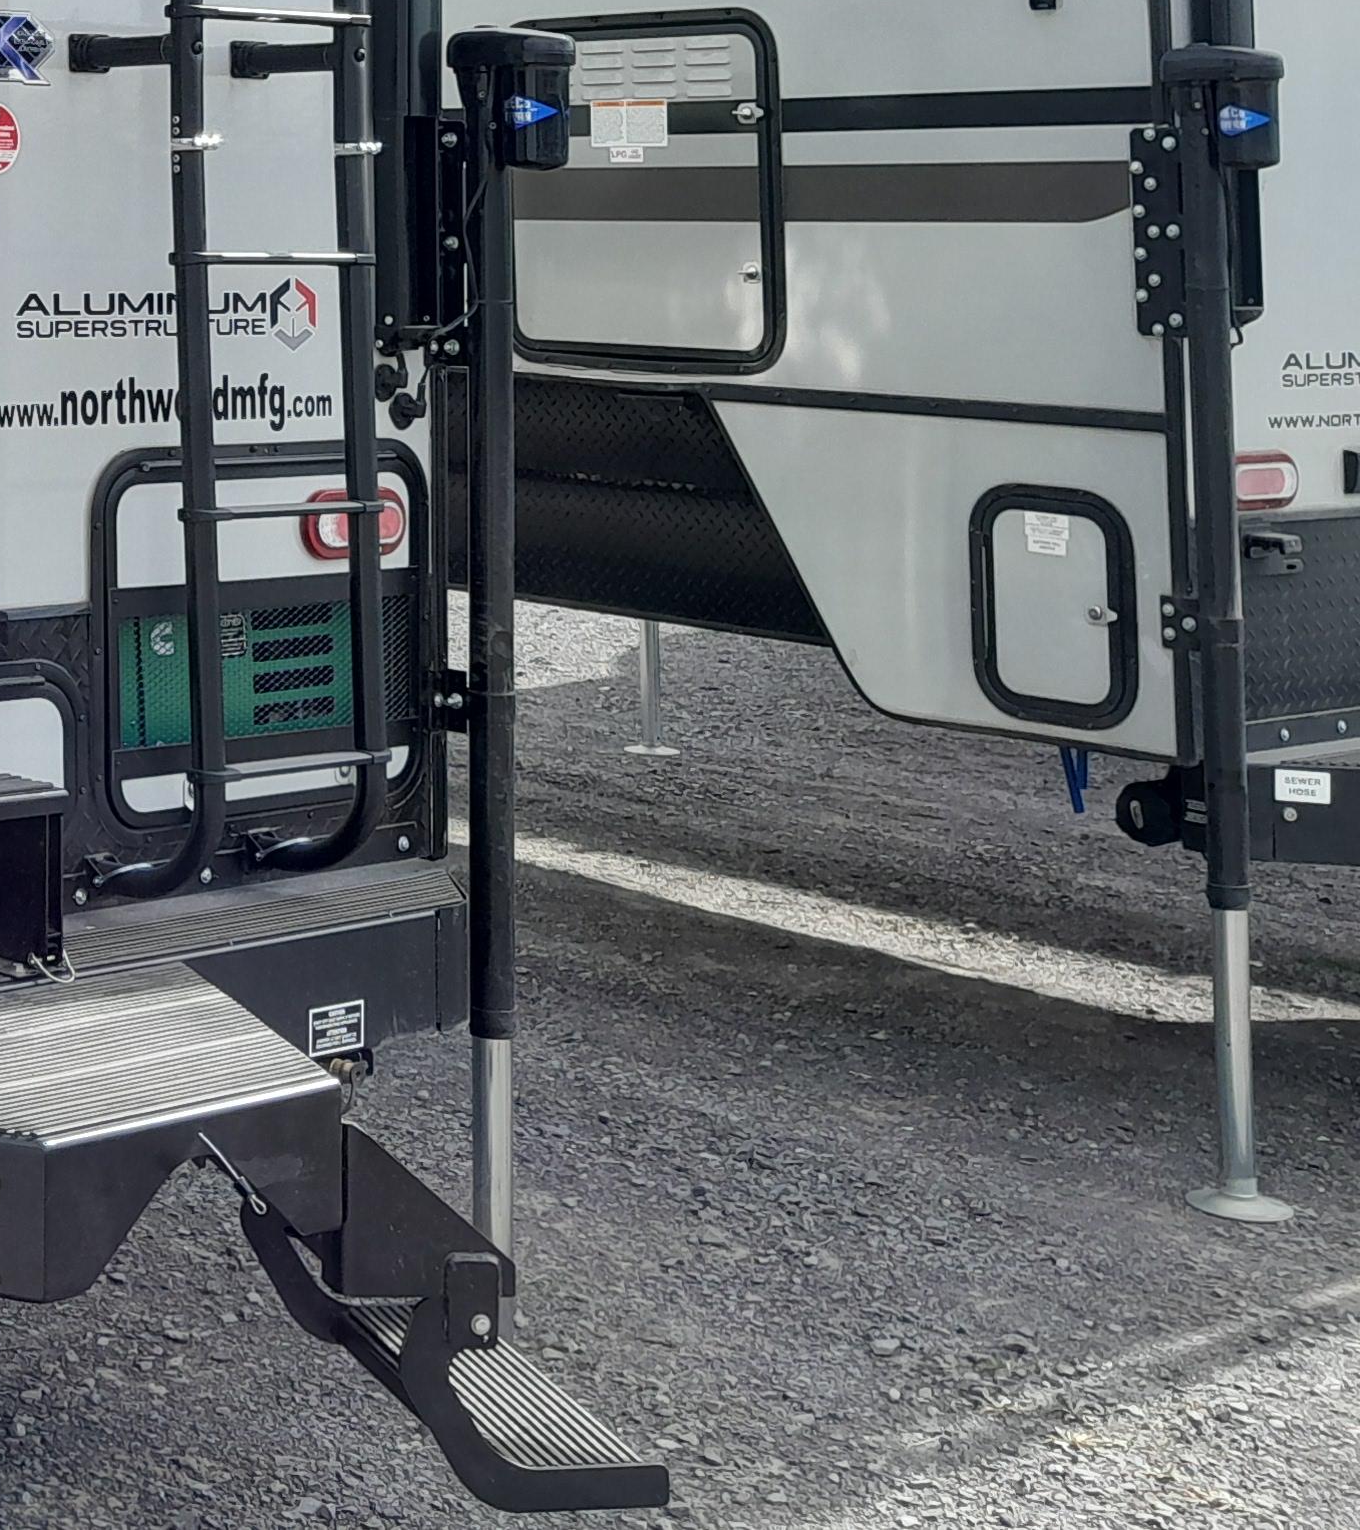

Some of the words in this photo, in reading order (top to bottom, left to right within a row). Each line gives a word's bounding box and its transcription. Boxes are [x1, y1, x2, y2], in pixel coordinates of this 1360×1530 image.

[16, 318, 267, 339] SUPERSTRUURE
[1284, 776, 1321, 785] SEWER
[1289, 788, 1317, 796] HOSE
